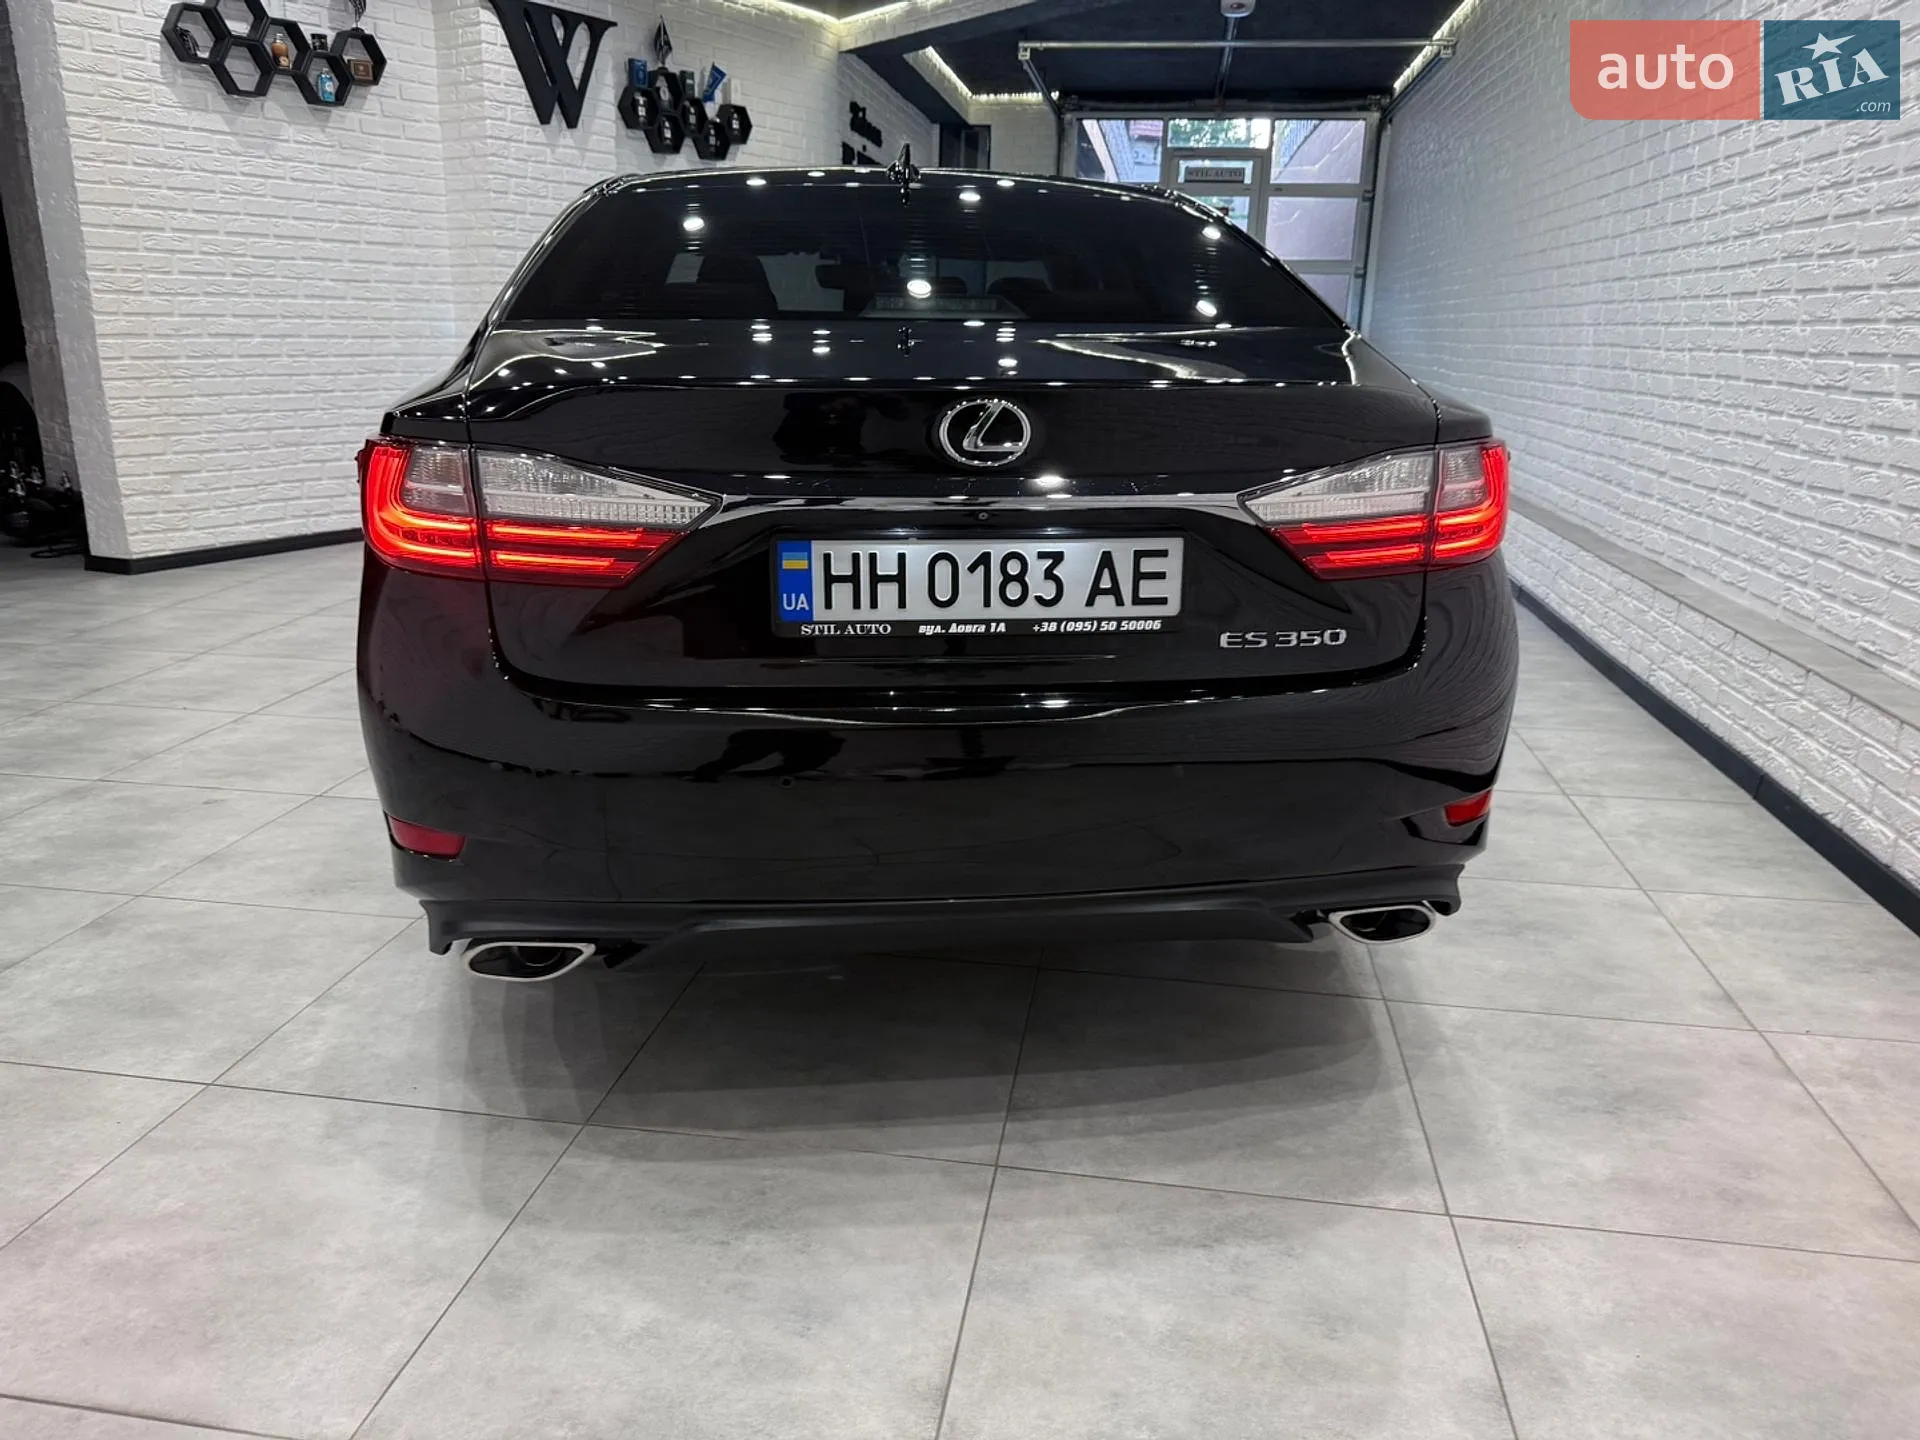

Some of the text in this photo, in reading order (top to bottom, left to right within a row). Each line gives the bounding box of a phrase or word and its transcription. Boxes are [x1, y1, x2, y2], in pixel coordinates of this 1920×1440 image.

[487, 0, 617, 129] W
[823, 549, 1170, 610] HH 0183 AE
[782, 593, 809, 611] UA
[800, 624, 892, 636] STIL AUTO
[1032, 619, 1162, 633] +38 (095) 50 50006
[1219, 629, 1347, 648] ES 350
